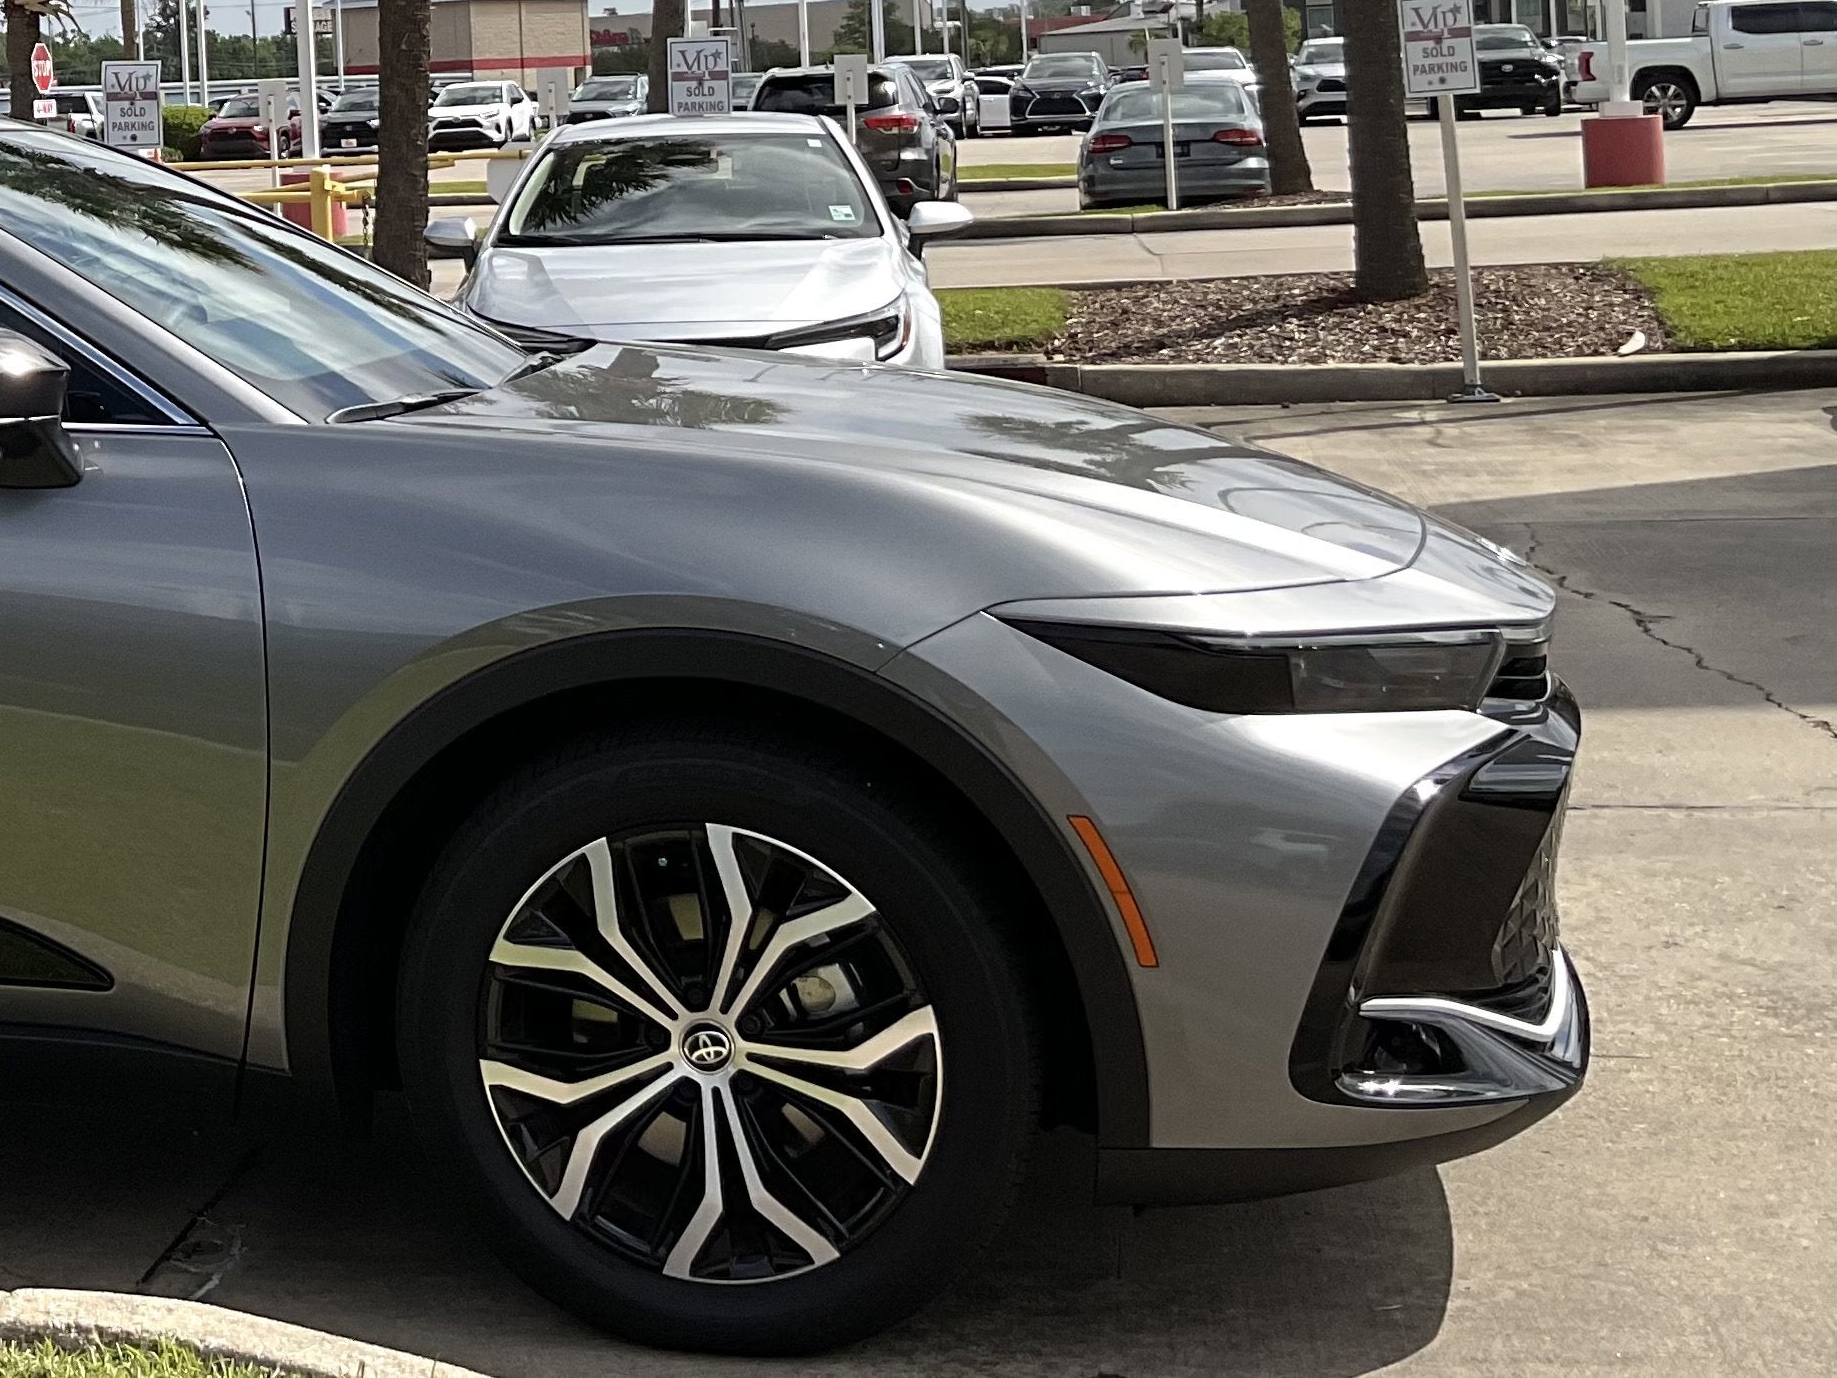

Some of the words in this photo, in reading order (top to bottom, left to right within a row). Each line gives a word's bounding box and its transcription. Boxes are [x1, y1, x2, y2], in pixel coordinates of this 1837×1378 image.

[1422, 45, 1456, 59] SOLD
[33, 60, 51, 77] STOP
[1412, 60, 1468, 77] PARKING
[686, 85, 715, 97] SOLD
[119, 106, 146, 118] SOLD
[677, 100, 725, 112] PARKING
[111, 120, 155, 132] PARKING
